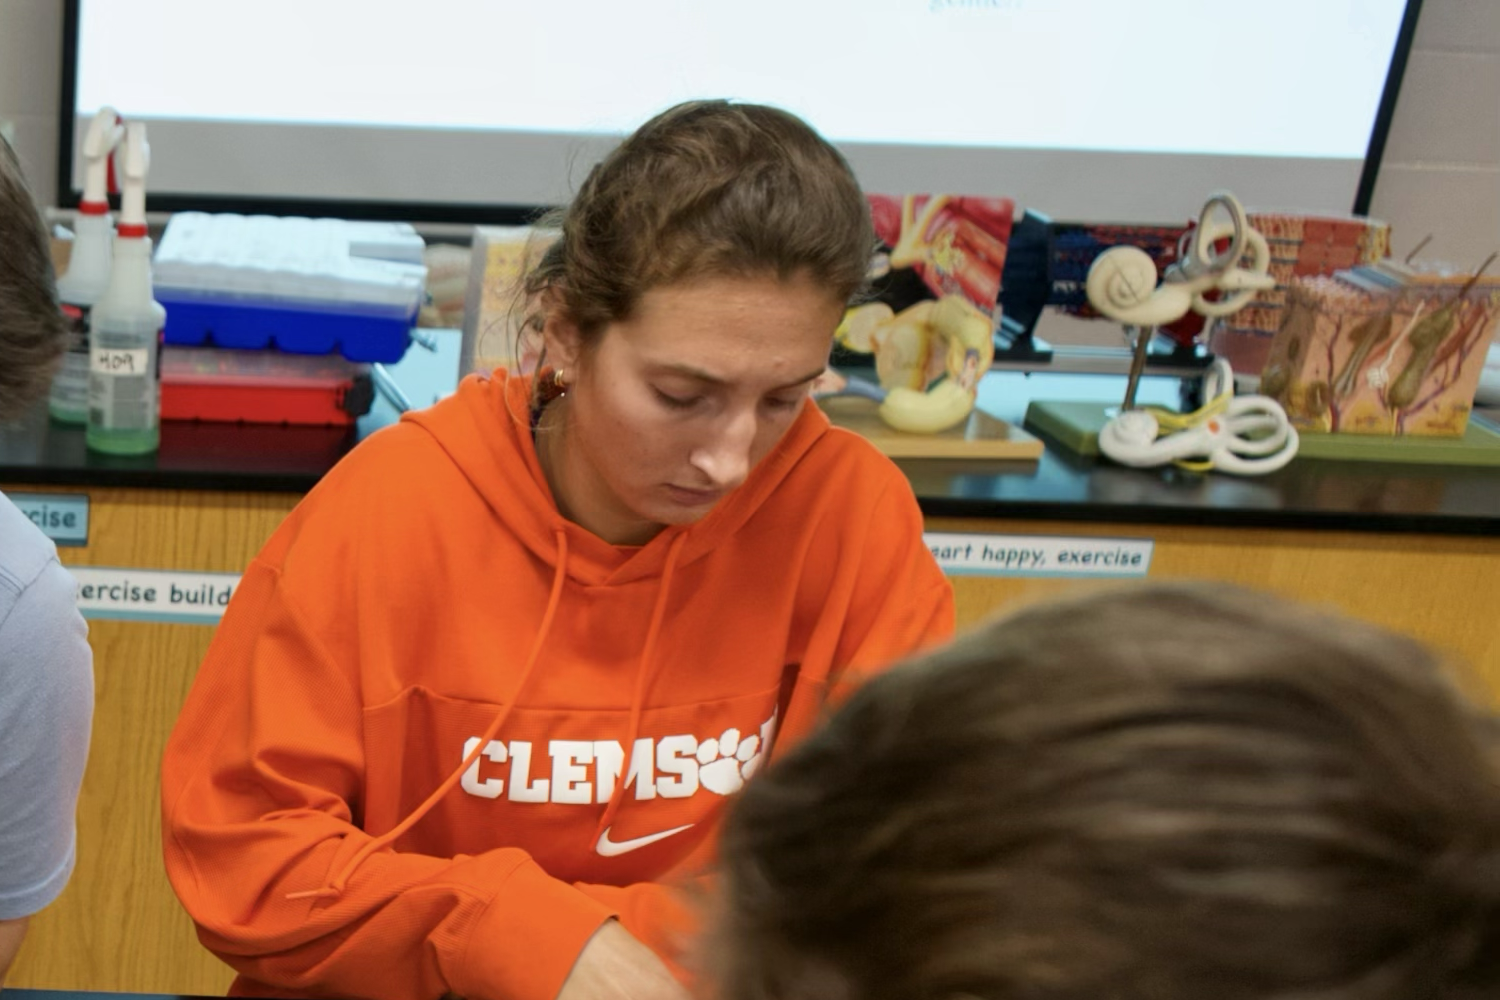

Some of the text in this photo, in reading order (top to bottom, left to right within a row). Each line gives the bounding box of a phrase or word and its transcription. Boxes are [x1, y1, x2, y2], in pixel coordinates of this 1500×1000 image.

[22, 505, 77, 528] cise
[982, 544, 1046, 569] happy,
[1057, 547, 1142, 566] exercise
[76, 580, 157, 604] ercise
